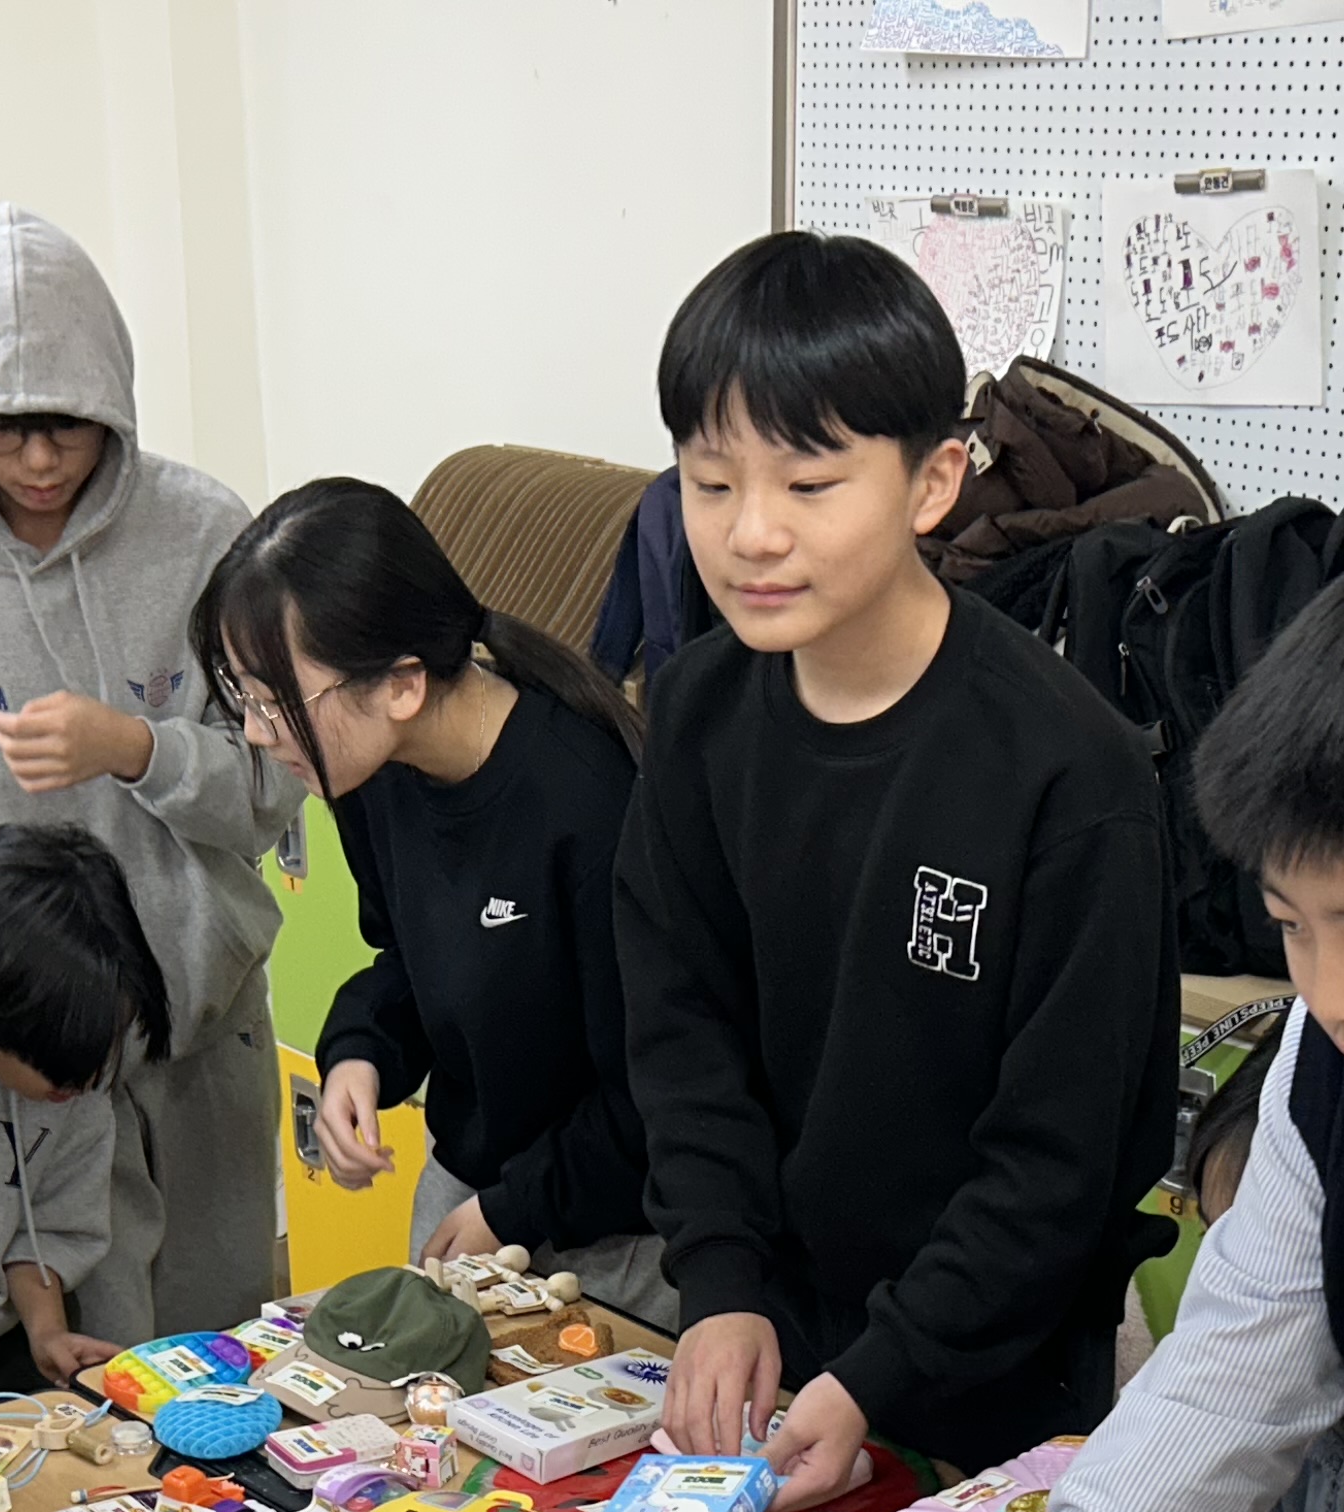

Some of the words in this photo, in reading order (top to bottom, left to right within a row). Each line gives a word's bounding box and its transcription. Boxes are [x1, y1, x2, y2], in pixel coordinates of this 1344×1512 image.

[487, 897, 516, 918] NIKE
[907, 866, 988, 981] H
[614, 1424, 649, 1439] Quality
